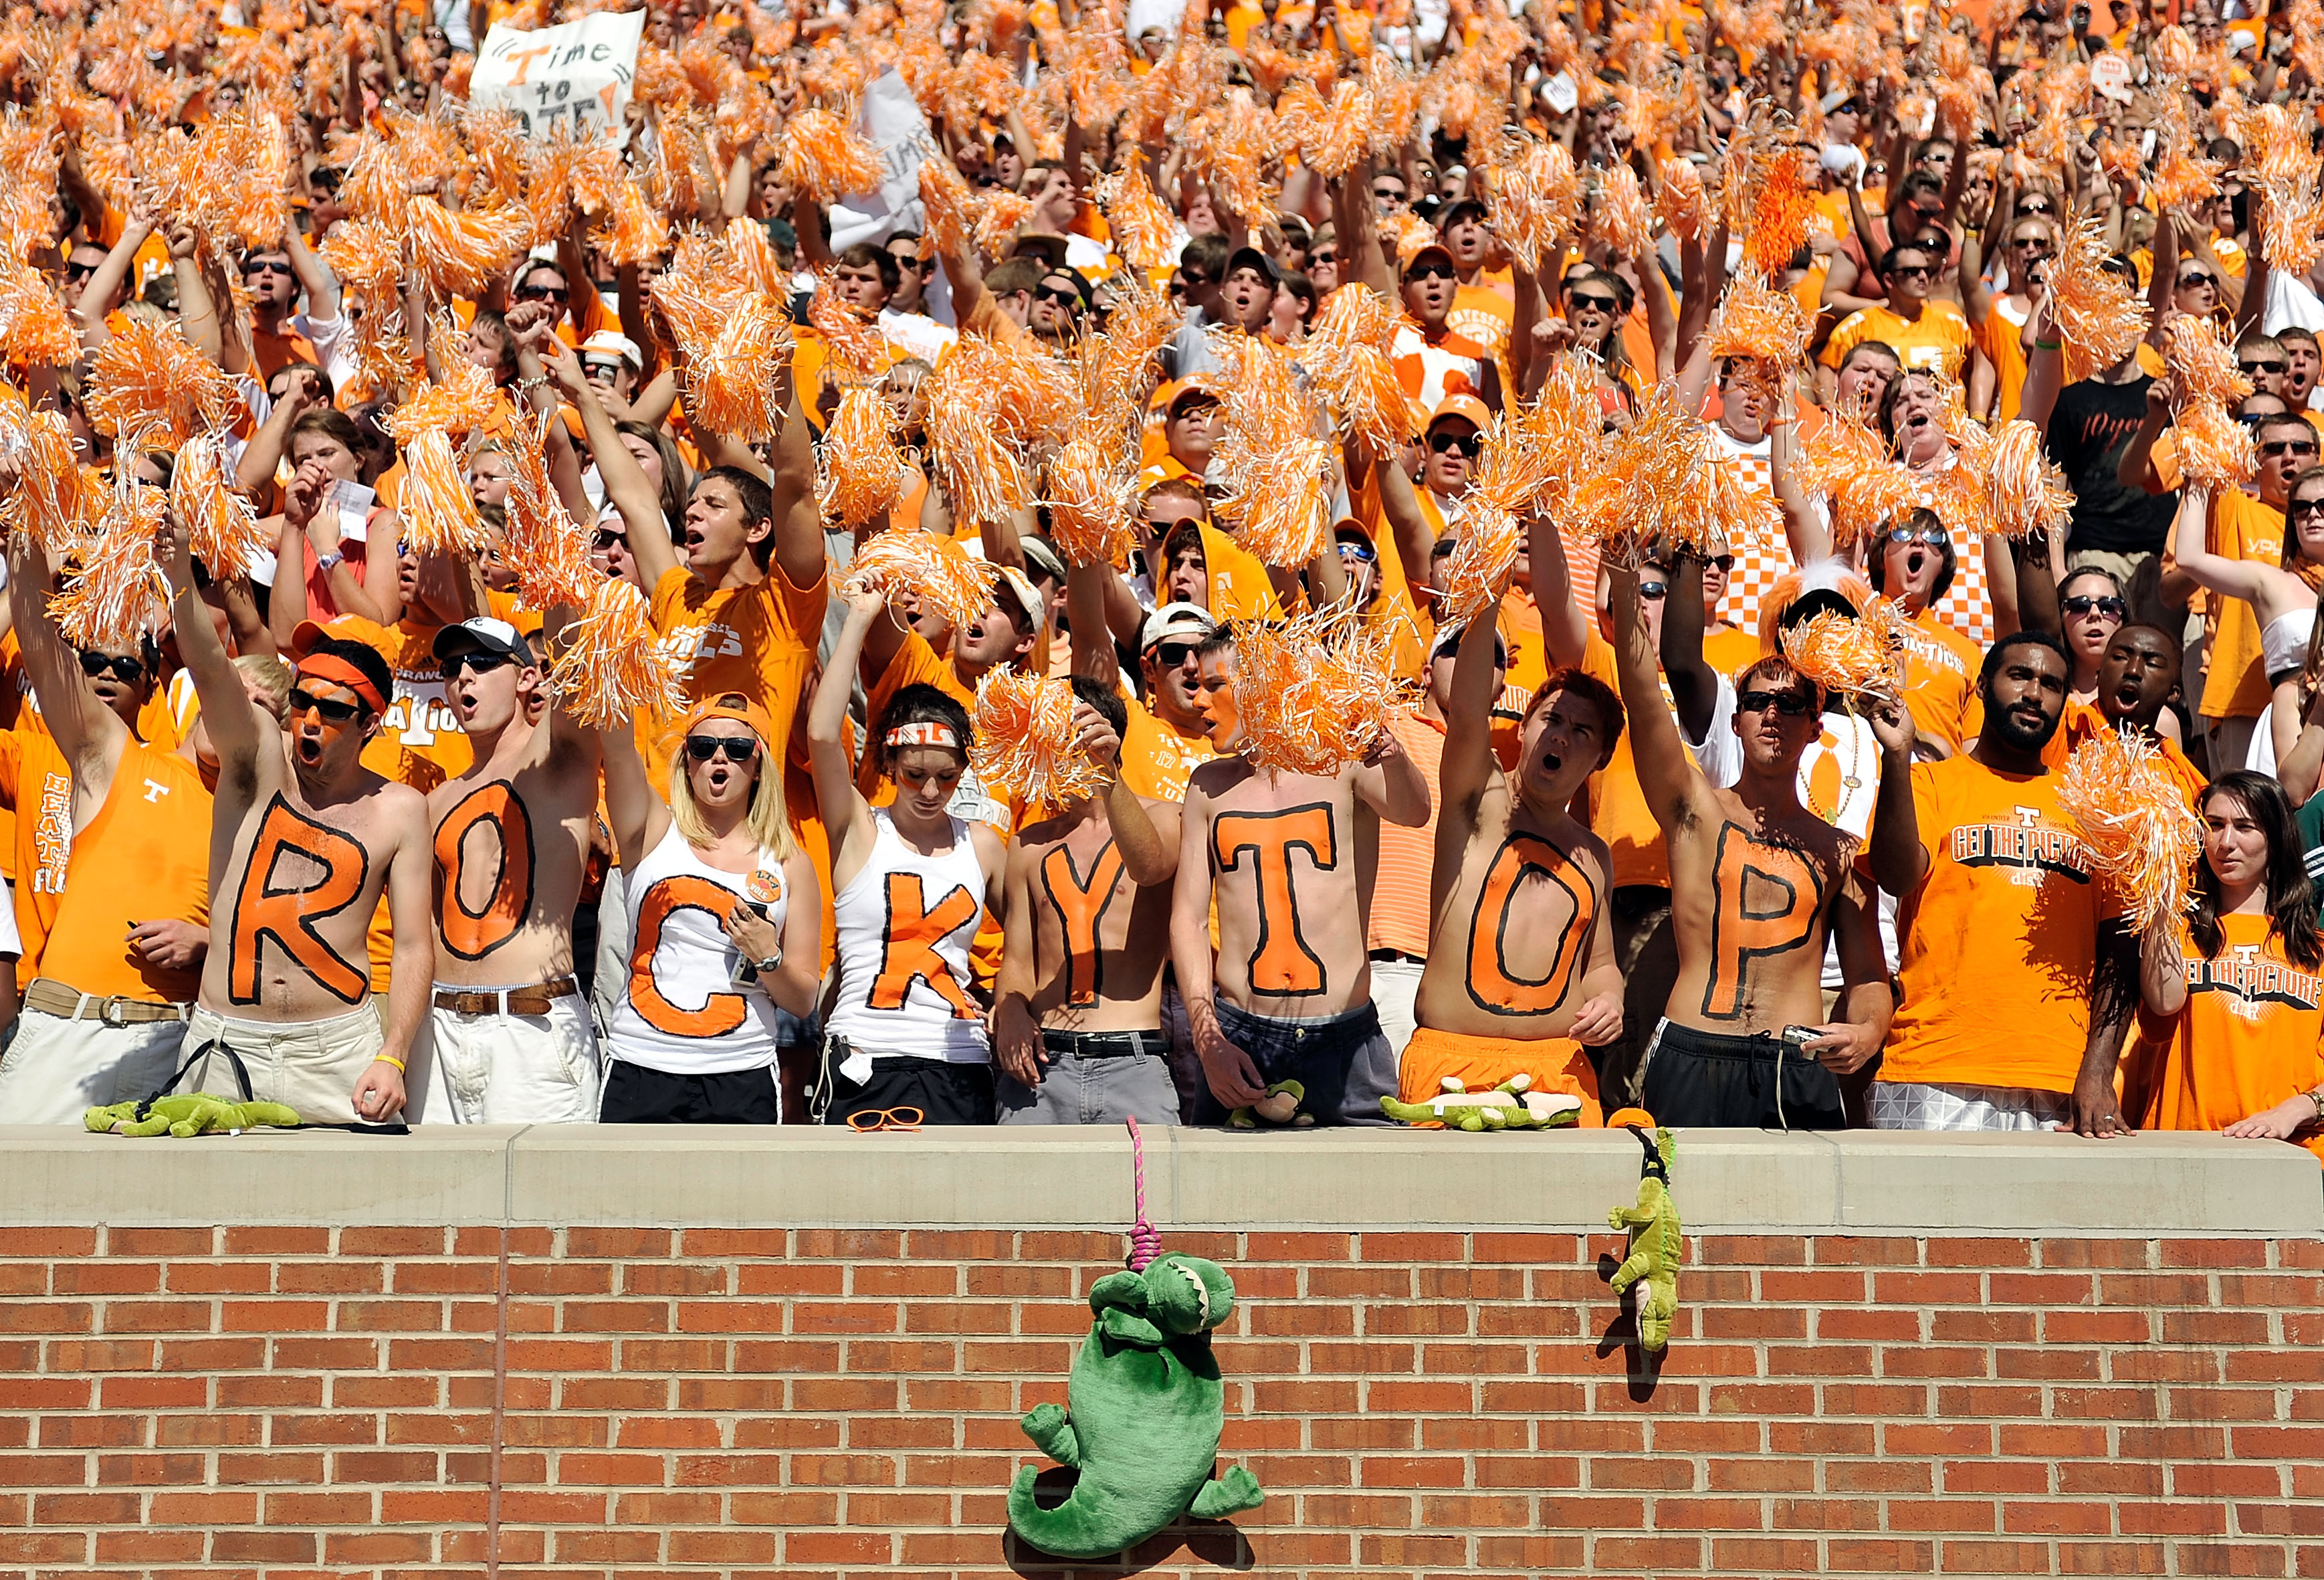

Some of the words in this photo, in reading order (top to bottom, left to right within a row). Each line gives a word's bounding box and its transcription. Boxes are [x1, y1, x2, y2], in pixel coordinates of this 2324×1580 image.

[536, 81, 570, 104] to
[1453, 395, 1475, 409] T
[395, 668, 444, 681] ORANG
[143, 777, 170, 803] T
[35, 771, 70, 864] BEAT
[2014, 805, 2042, 828] T
[433, 779, 535, 961] O
[1951, 823, 1988, 862] GET
[1988, 823, 2024, 860] THE
[2025, 828, 2091, 874] PICTU
[228, 789, 368, 1005] R
[749, 882, 768, 900] VOLS
[755, 870, 779, 890] ZTA
[1212, 801, 1337, 997] T
[865, 872, 978, 1019] K
[1041, 836, 1126, 1009] Y
[1465, 830, 1596, 1017] O
[1700, 820, 1824, 1020] P
[2233, 944, 2261, 965] T
[2183, 957, 2206, 985] ET
[2206, 959, 2243, 991] THE
[2244, 963, 2323, 1010] PICTURE
